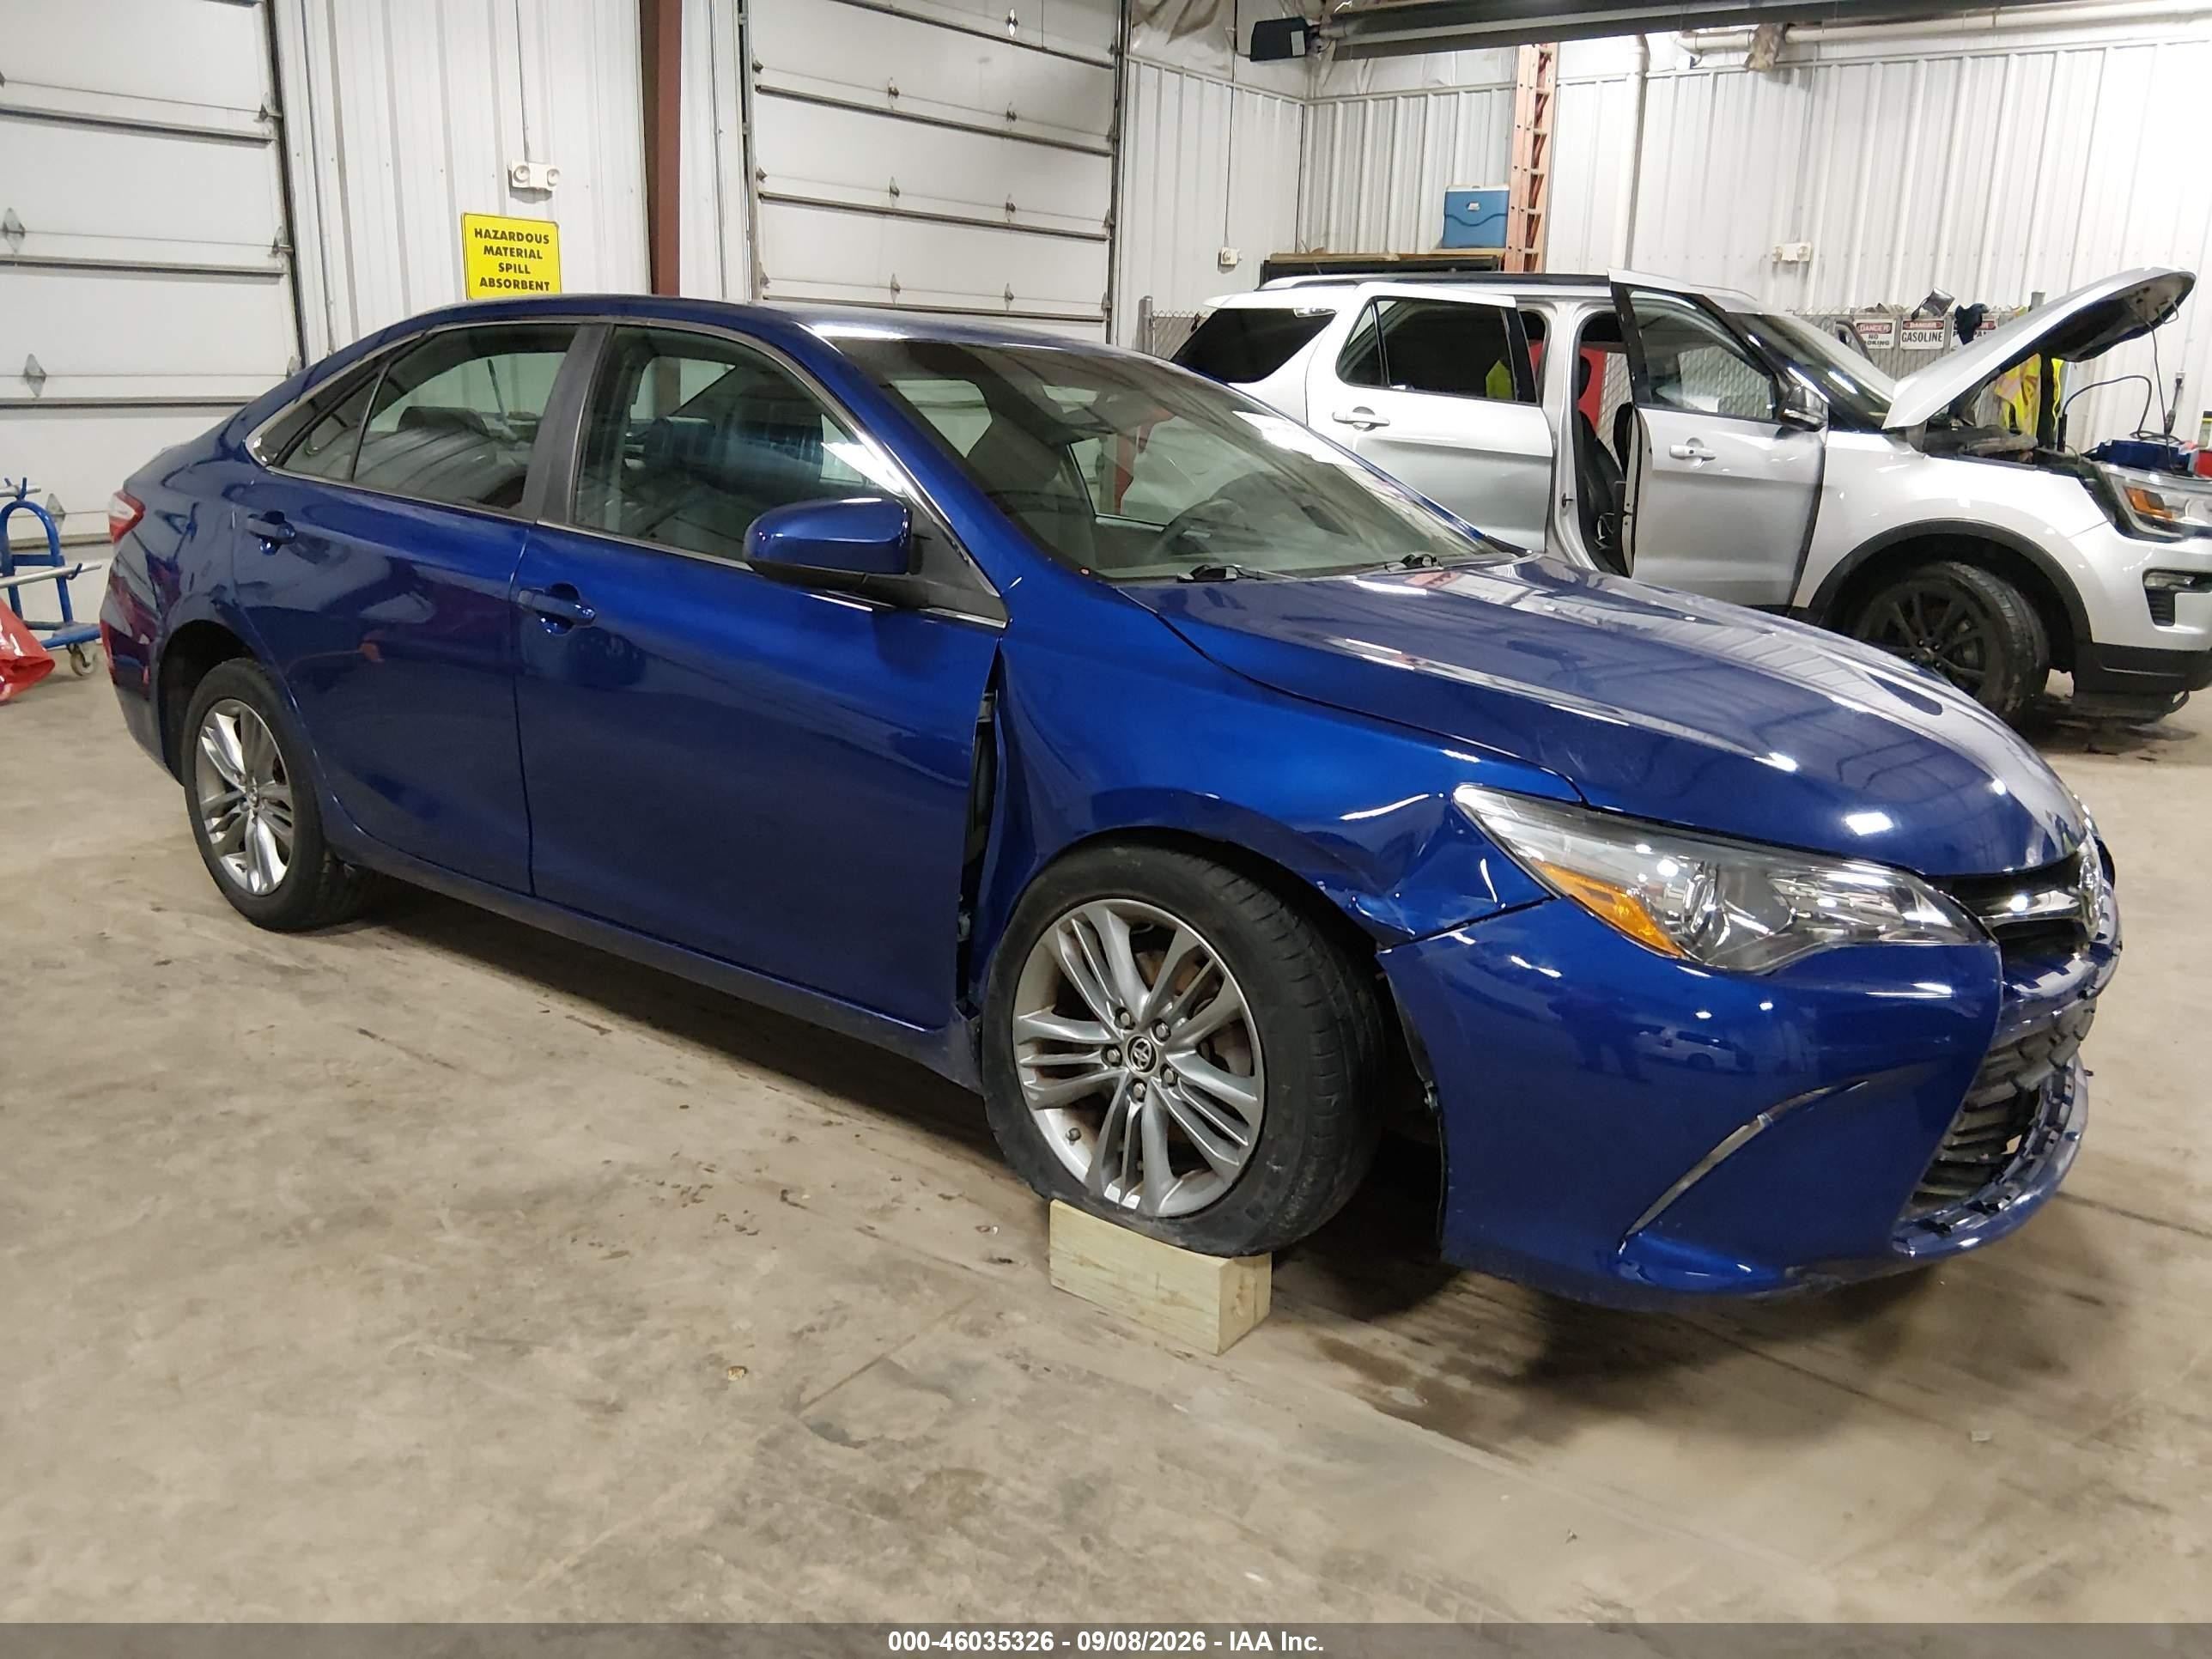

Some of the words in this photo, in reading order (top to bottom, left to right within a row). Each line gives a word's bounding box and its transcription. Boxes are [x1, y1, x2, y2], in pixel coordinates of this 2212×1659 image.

[474, 228, 550, 245] HAZARDOUS
[483, 245, 543, 259] MATERIAL
[498, 262, 532, 275] SPILL
[479, 276, 550, 291] ABSORBENT
[1901, 331, 1943, 343] GASOLINE
